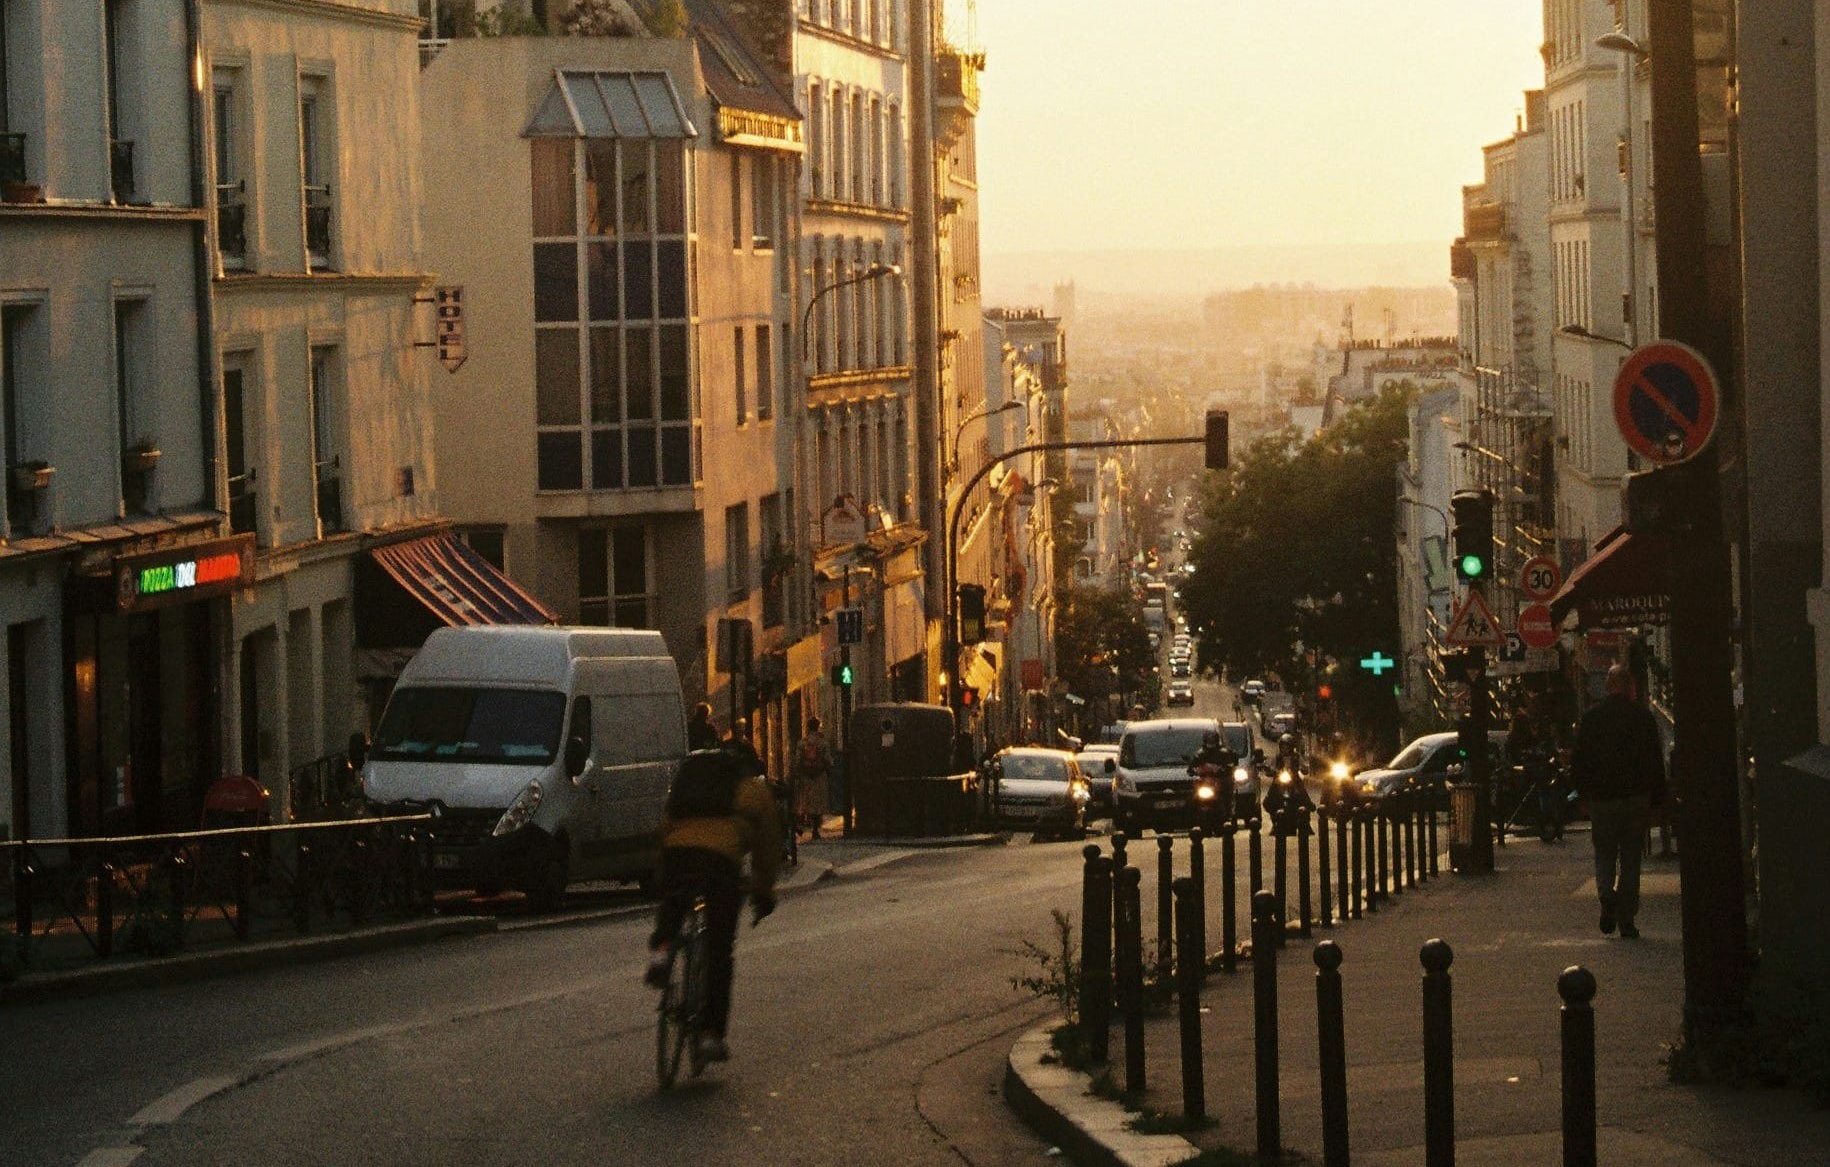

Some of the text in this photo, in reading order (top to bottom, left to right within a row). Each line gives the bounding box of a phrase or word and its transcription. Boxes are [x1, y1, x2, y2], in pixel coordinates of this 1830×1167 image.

[438, 290, 461, 360] HOTEL
[1531, 570, 1553, 589] 30
[1507, 637, 1521, 657] P
